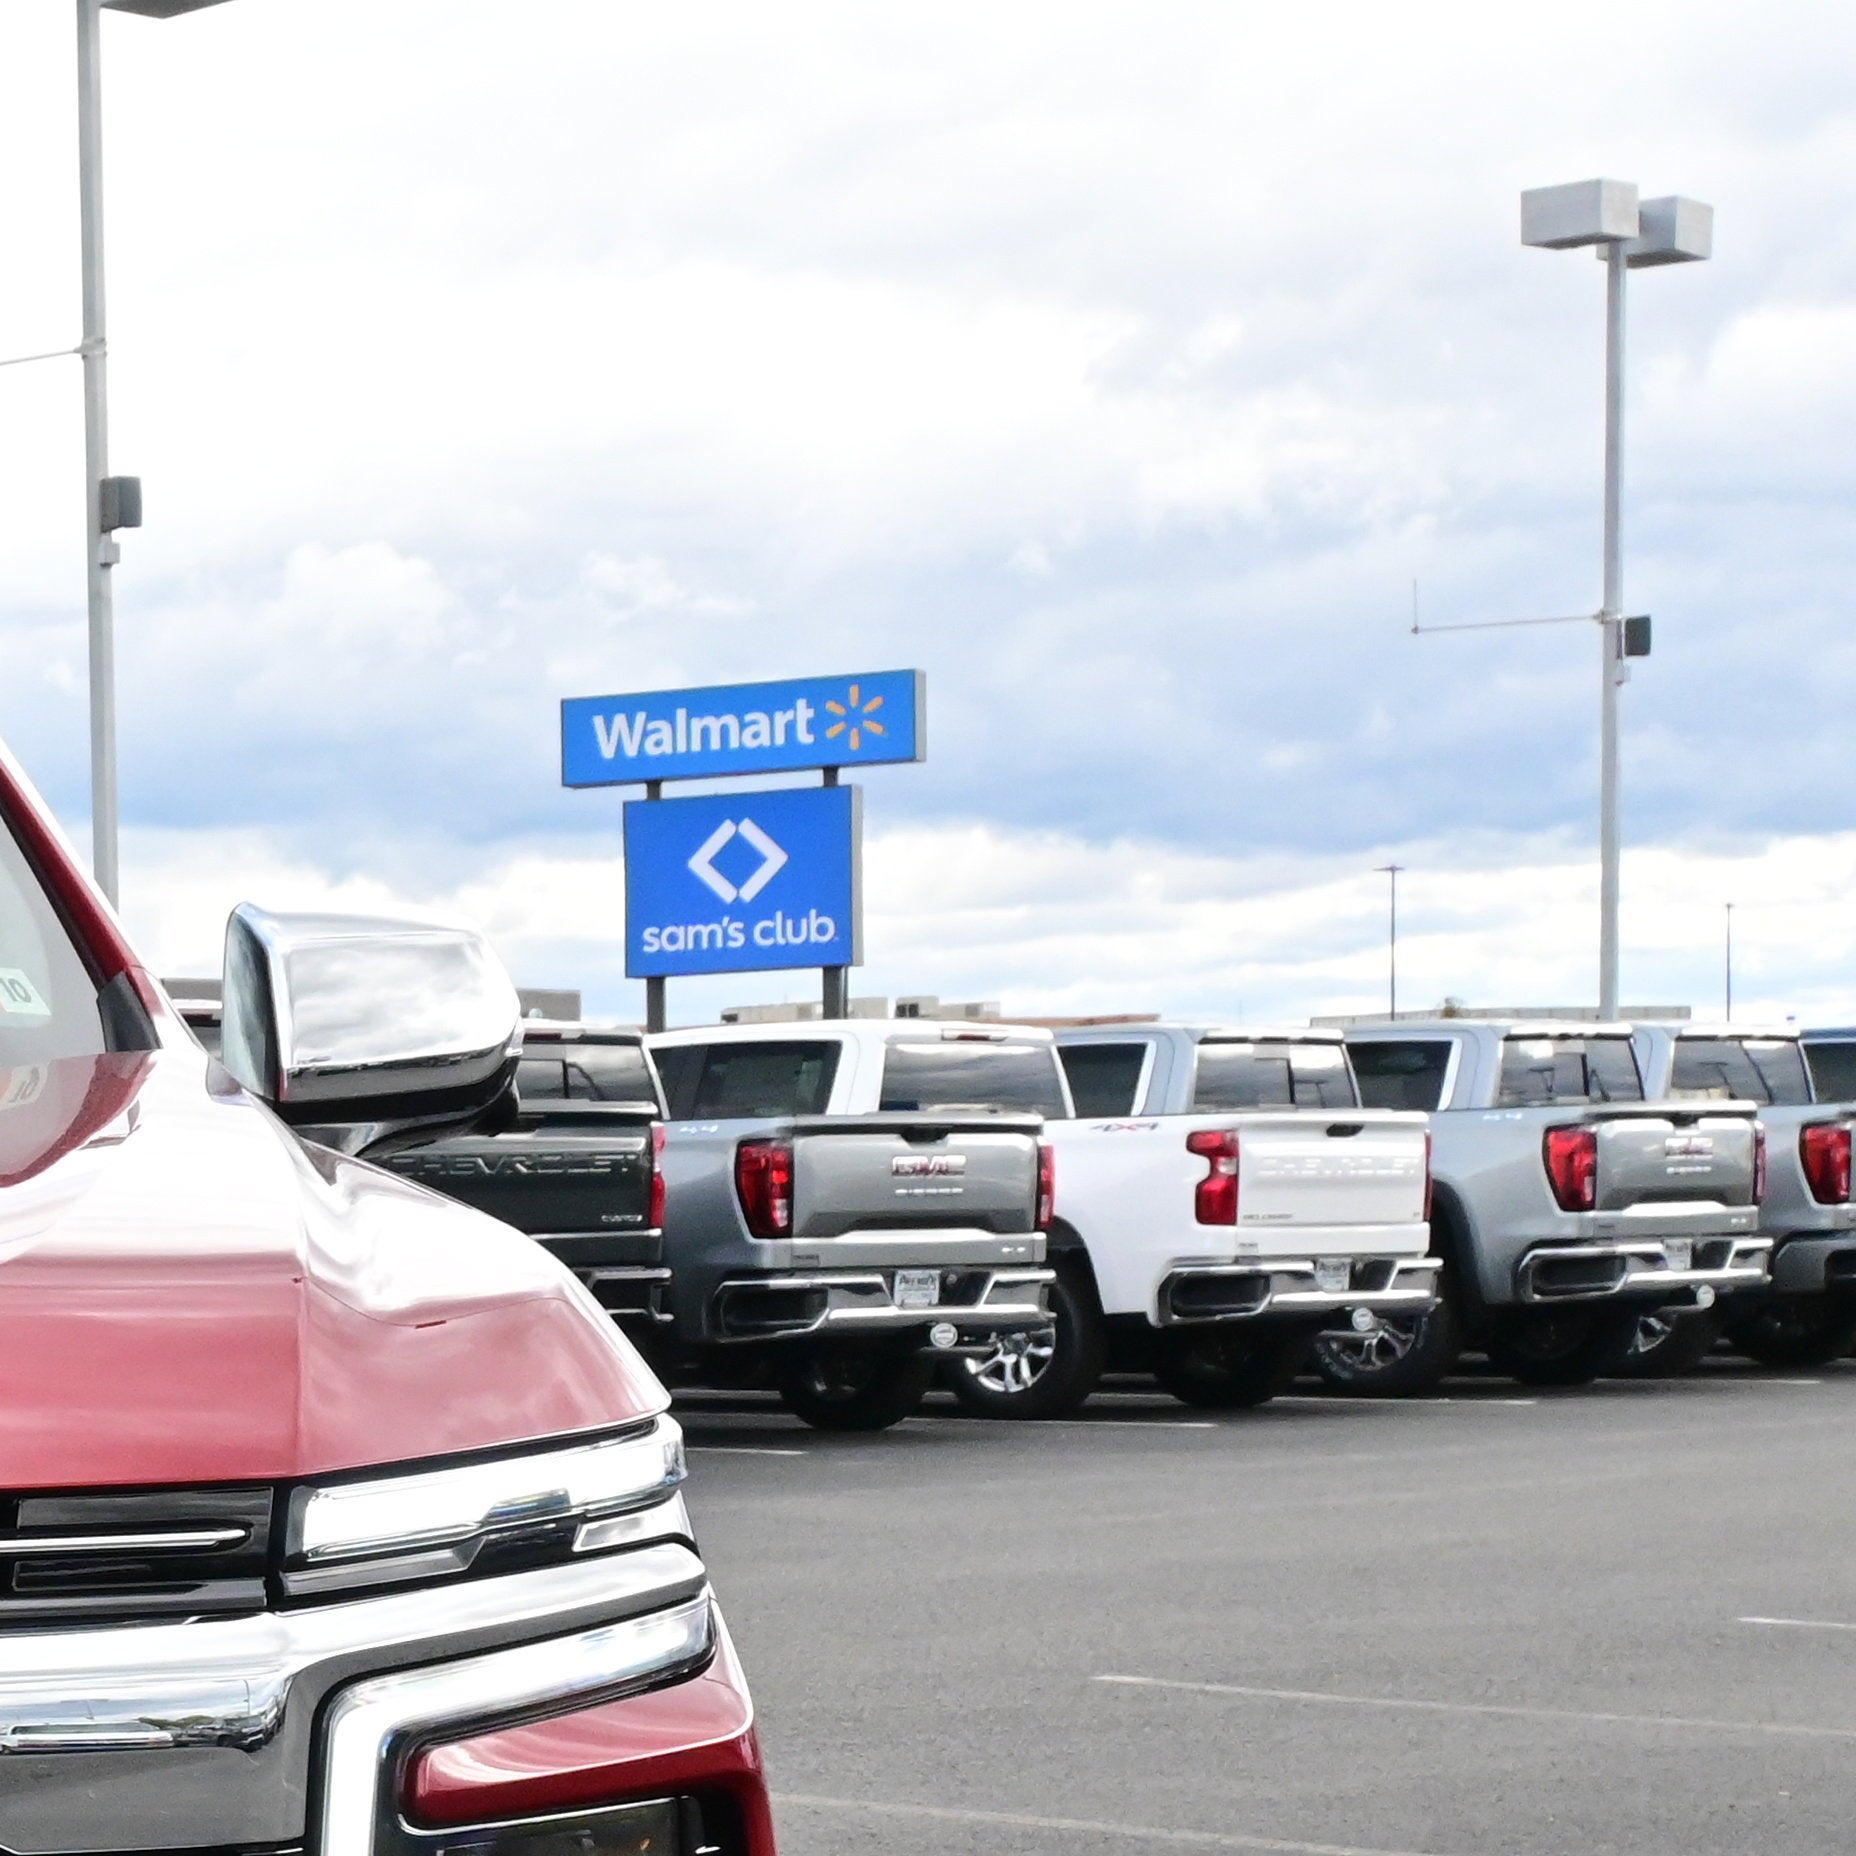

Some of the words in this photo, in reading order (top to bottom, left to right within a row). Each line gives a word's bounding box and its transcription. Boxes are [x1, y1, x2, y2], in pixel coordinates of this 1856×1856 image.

[592, 698, 815, 760] Walmart
[642, 914, 746, 953] sam's
[753, 908, 836, 947] club
[388, 1153, 640, 1176] CHEVROLET
[891, 1154, 967, 1178] GMC
